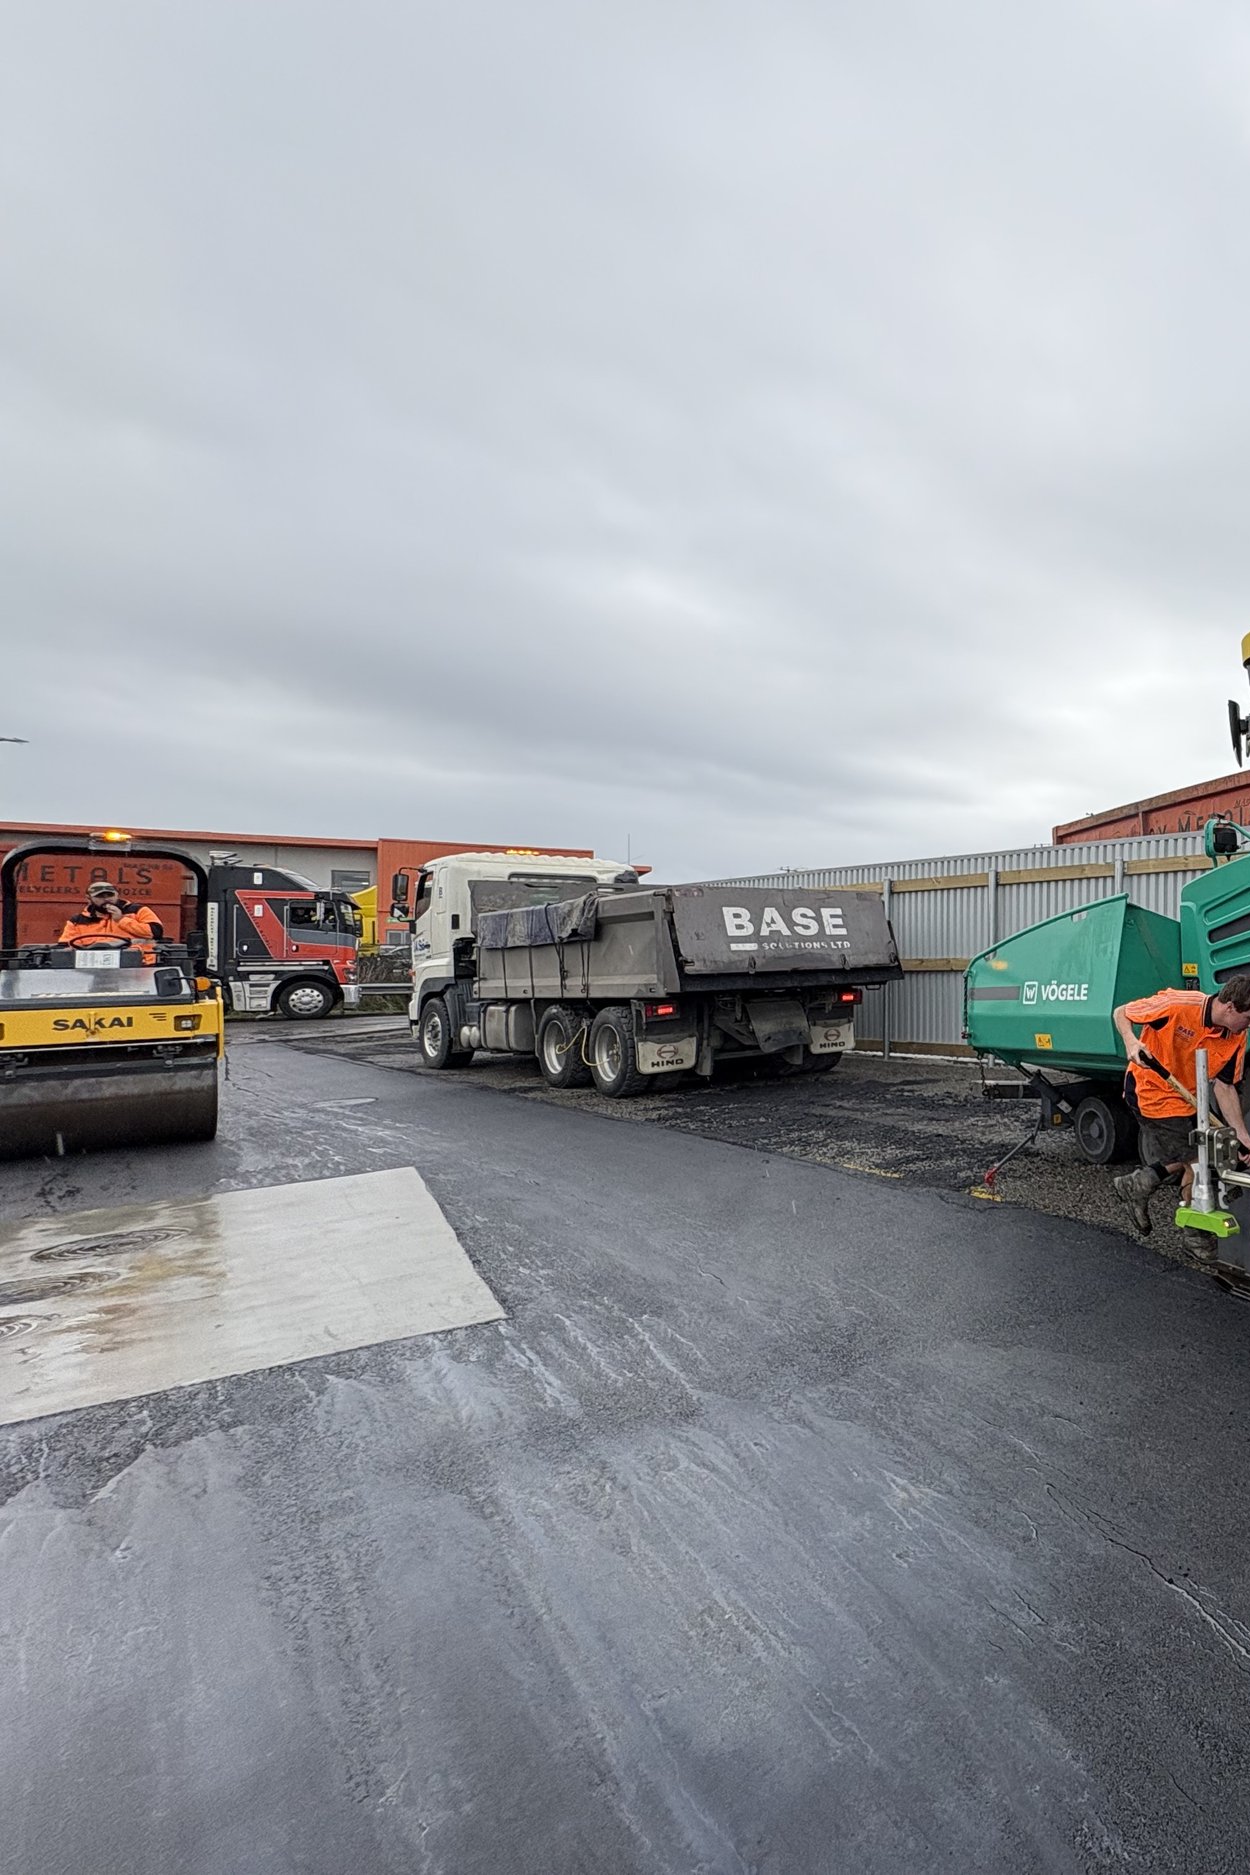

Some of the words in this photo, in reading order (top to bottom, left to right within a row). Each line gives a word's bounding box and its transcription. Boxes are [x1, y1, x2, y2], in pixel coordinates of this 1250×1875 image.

[721, 906, 848, 937] BASE
[830, 941, 851, 949] LTD
[1041, 980, 1089, 1001] VÖGELE
[52, 1016, 134, 1032] SAKAI
[819, 1040, 846, 1049] HINO
[651, 1058, 684, 1068] HINO
